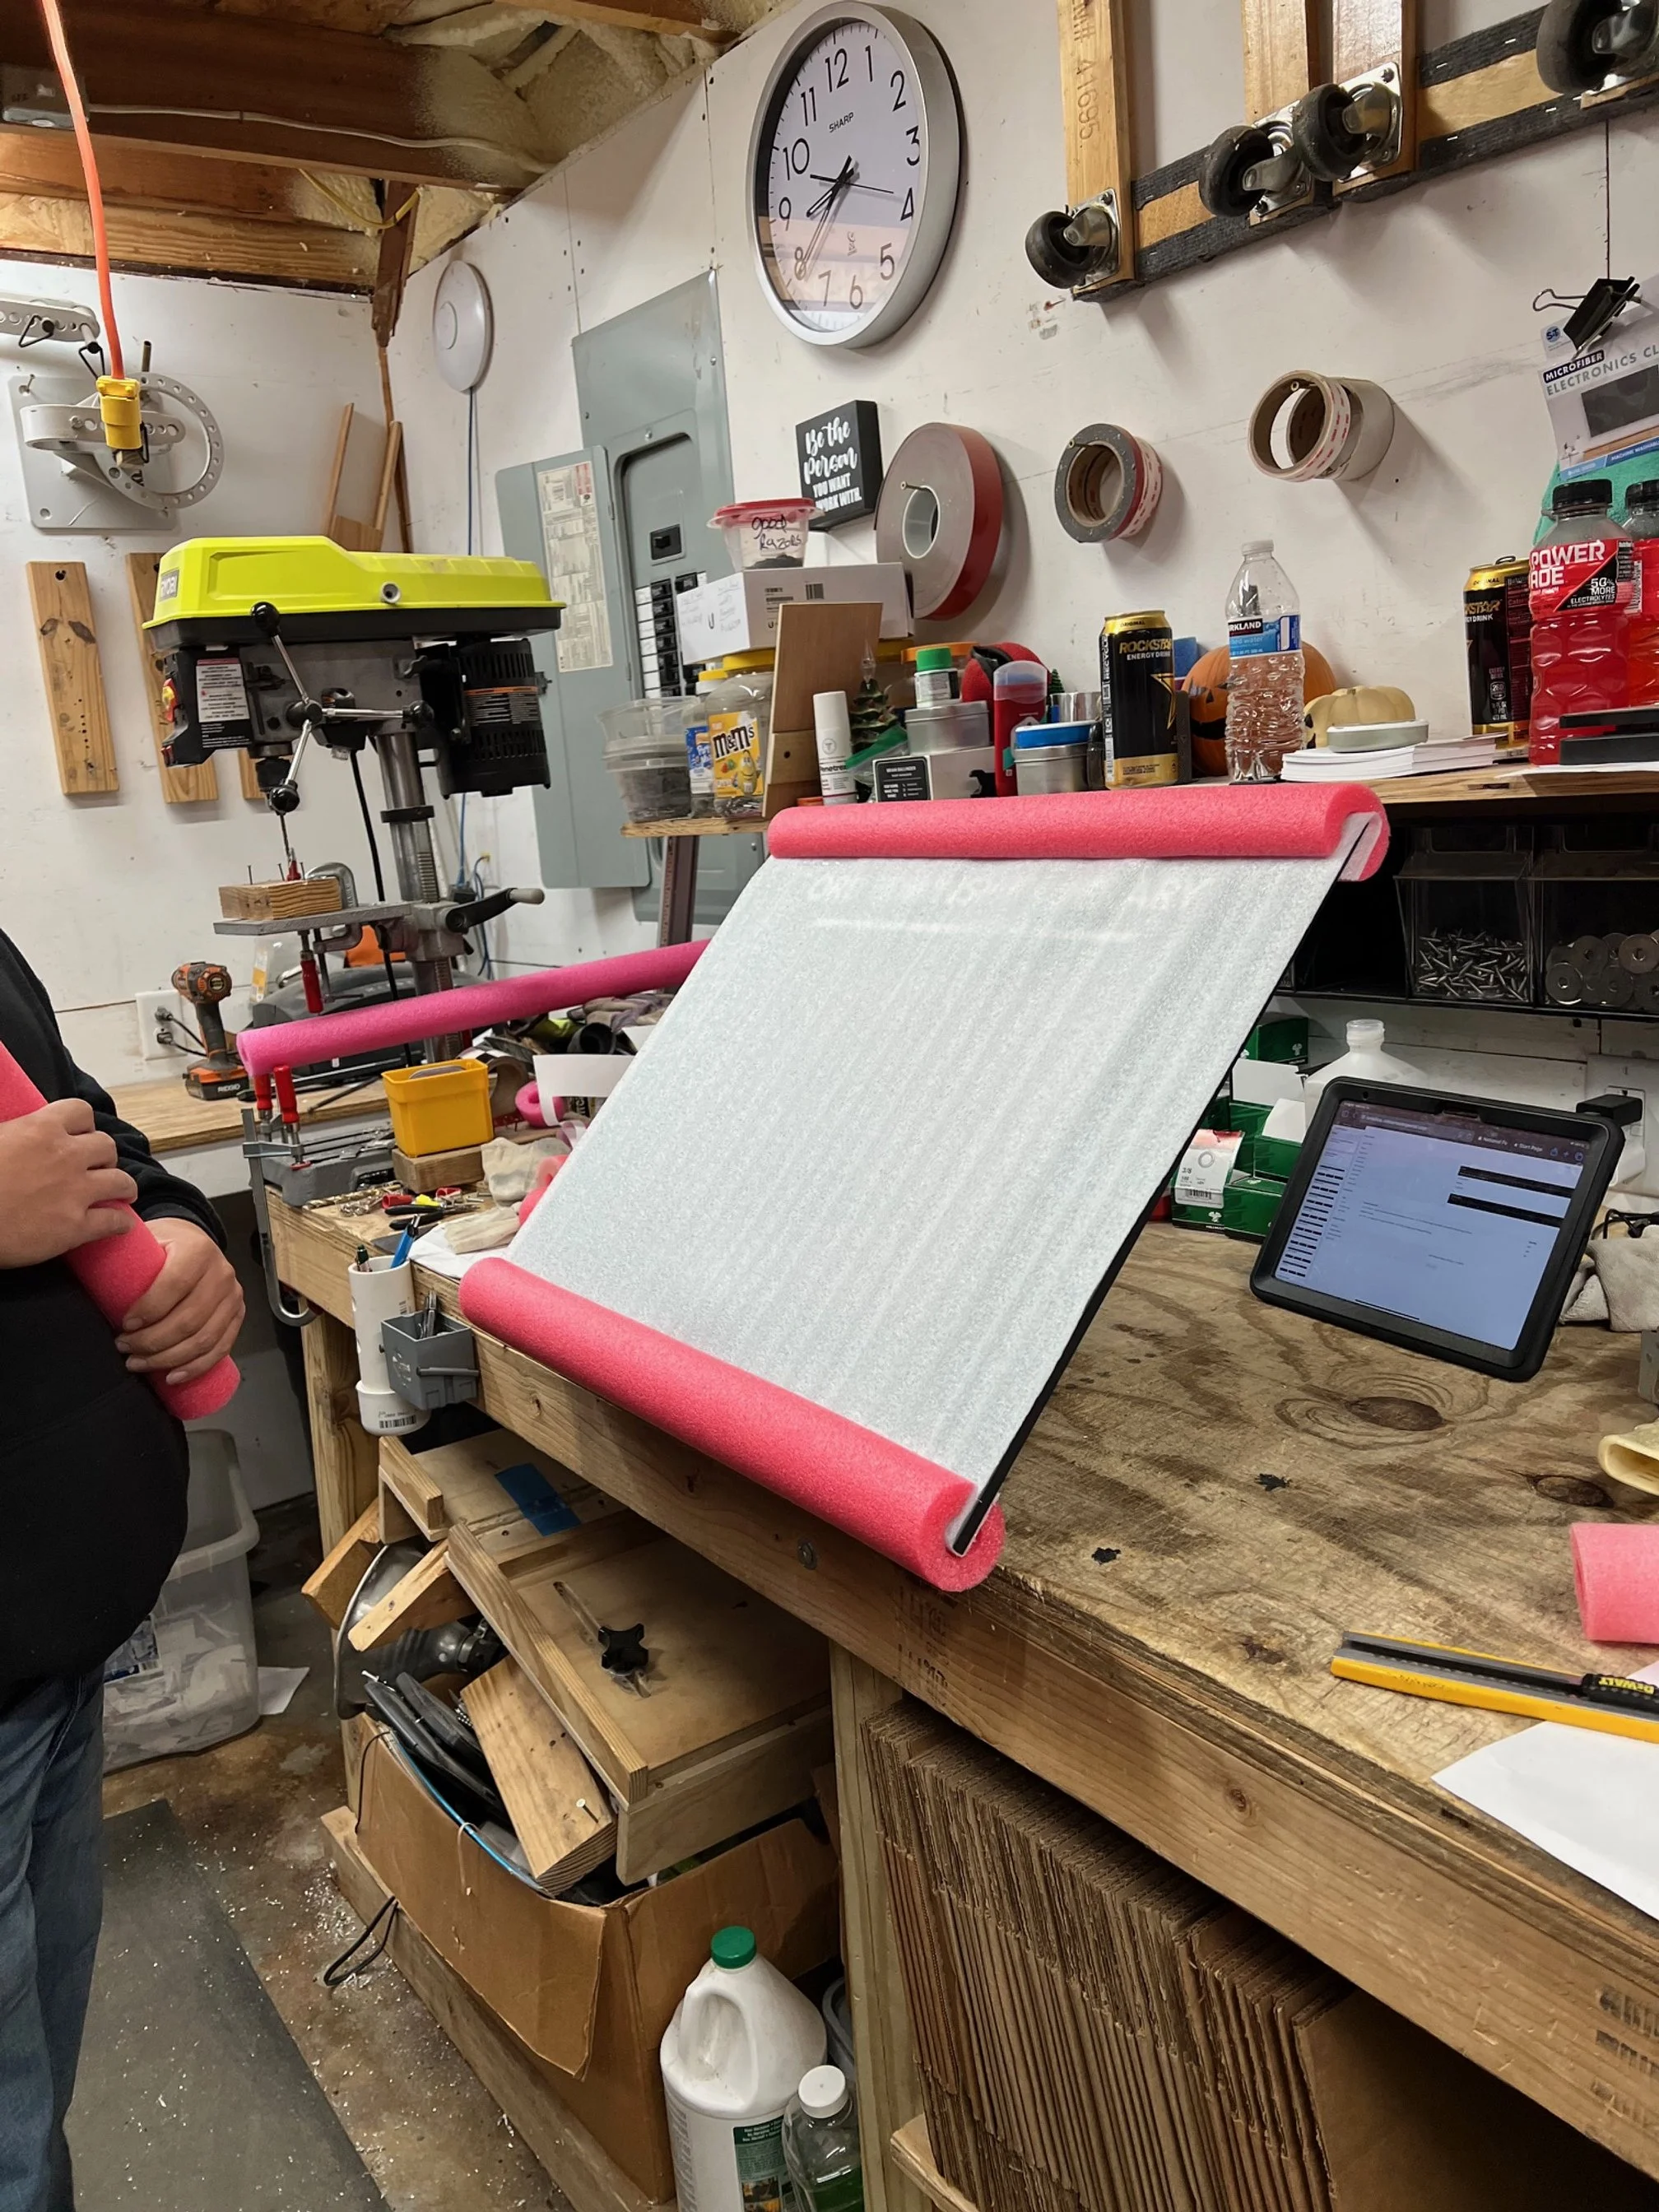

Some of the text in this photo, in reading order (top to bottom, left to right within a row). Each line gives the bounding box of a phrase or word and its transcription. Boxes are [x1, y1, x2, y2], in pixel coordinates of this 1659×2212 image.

[825, 48, 849, 93] 12
[865, 44, 873, 82] 1
[801, 86, 817, 127] 11
[890, 70, 906, 112] 2
[829, 111, 855, 133] SHARP
[783, 137, 810, 181] 10
[905, 125, 921, 167] 3
[778, 197, 792, 231] 9
[899, 187, 914, 222] 4
[793, 246, 806, 281] 8
[880, 243, 895, 281] 5
[819, 269, 832, 308] 7
[849, 275, 863, 310] 6
[1545, 352, 1604, 383] MICROFIBER
[1546, 343, 1659, 396] ELECTRONICS CL
[806, 416, 851, 457] Be the
[803, 447, 857, 485] person
[812, 472, 851, 499] YOU WANT
[751, 514, 787, 539] good
[1531, 541, 1606, 571] POWER
[160, 575, 177, 597] RYOBI
[1530, 565, 1564, 590] ADE
[1591, 586, 1616, 596] MORE
[1570, 594, 1615, 605] ELECTROLYTES
[1472, 613, 1494, 623] DRINK
[1127, 652, 1155, 662] ENERGY
